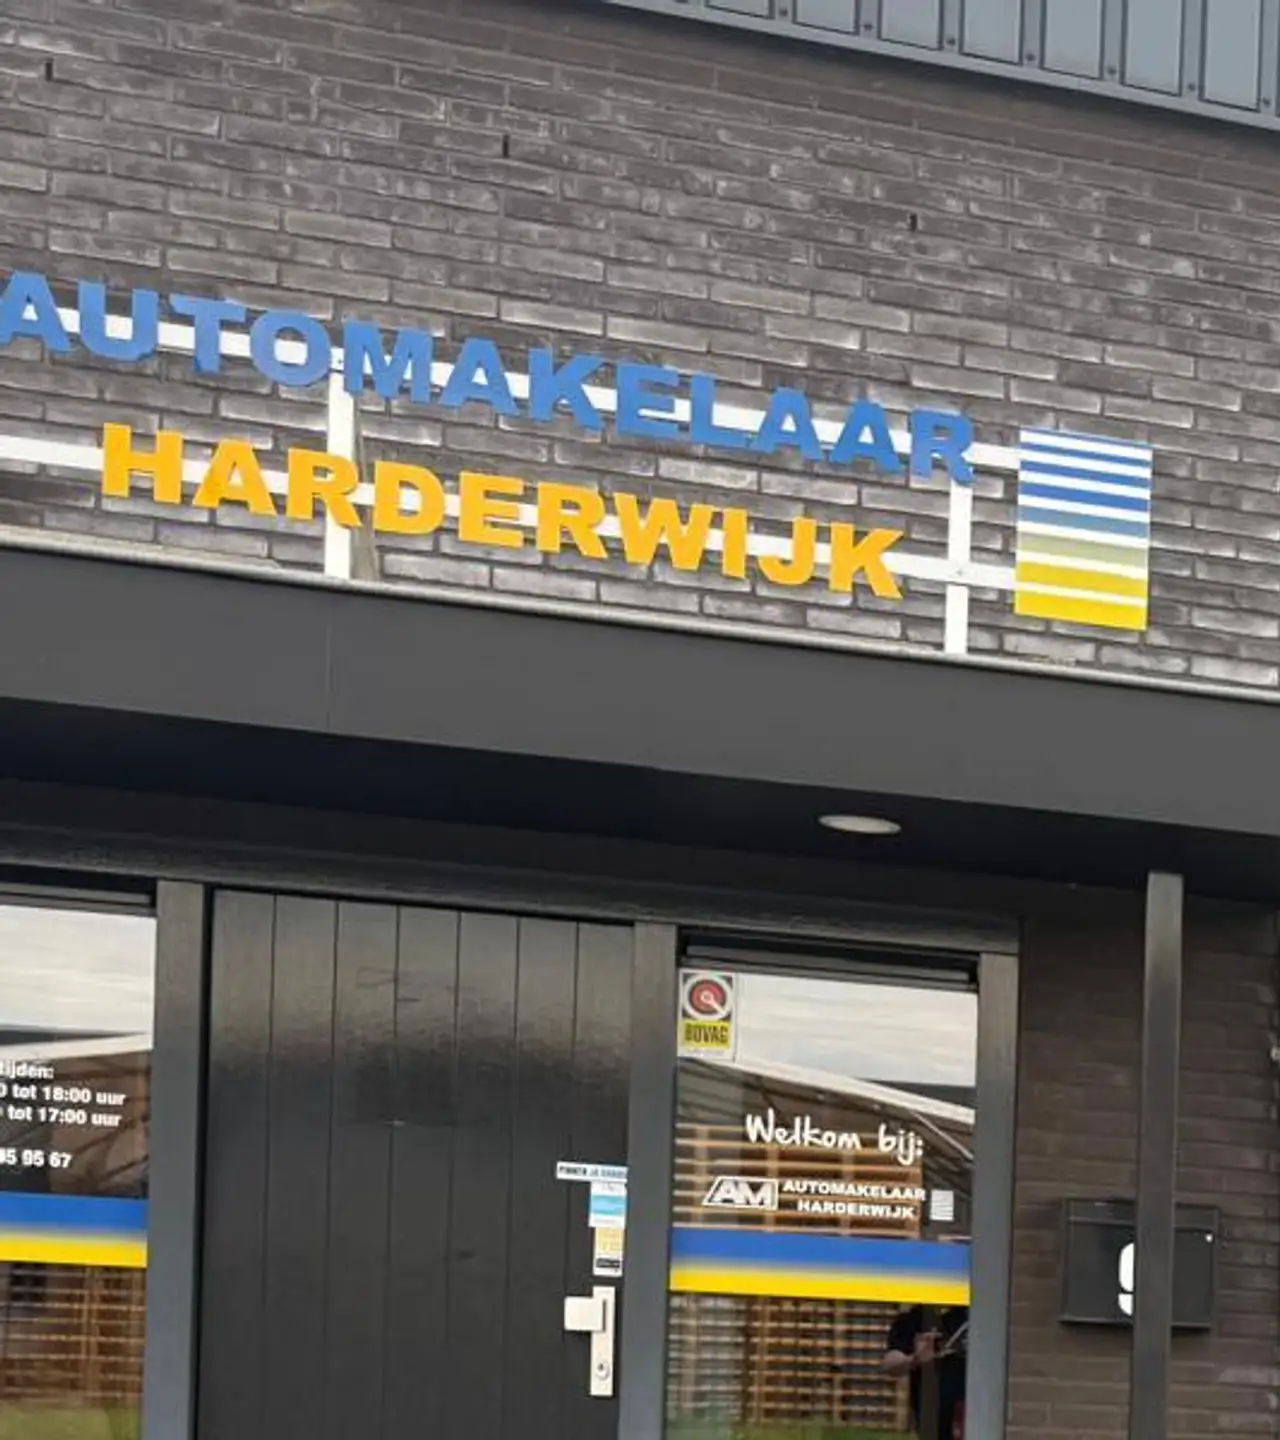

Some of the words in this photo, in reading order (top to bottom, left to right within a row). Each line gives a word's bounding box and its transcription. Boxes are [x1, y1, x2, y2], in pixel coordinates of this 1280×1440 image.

[0, 270, 977, 485] AUTOMAKELAAR
[100, 423, 905, 600] HARDERWIJK
[12, 1084, 37, 1100] tot
[42, 1086, 92, 1103] 18:00
[96, 1091, 126, 1106] uur
[7, 1104, 33, 1122] tot
[38, 1107, 87, 1125] 17:00
[91, 1113, 122, 1127] uur
[746, 1108, 862, 1150] Welkom
[878, 1122, 924, 1166] bij:
[48, 1152, 72, 1169] 67
[783, 1179, 926, 1201] AUTOMAKELAAR
[797, 1200, 915, 1220] HARDERWIJK
